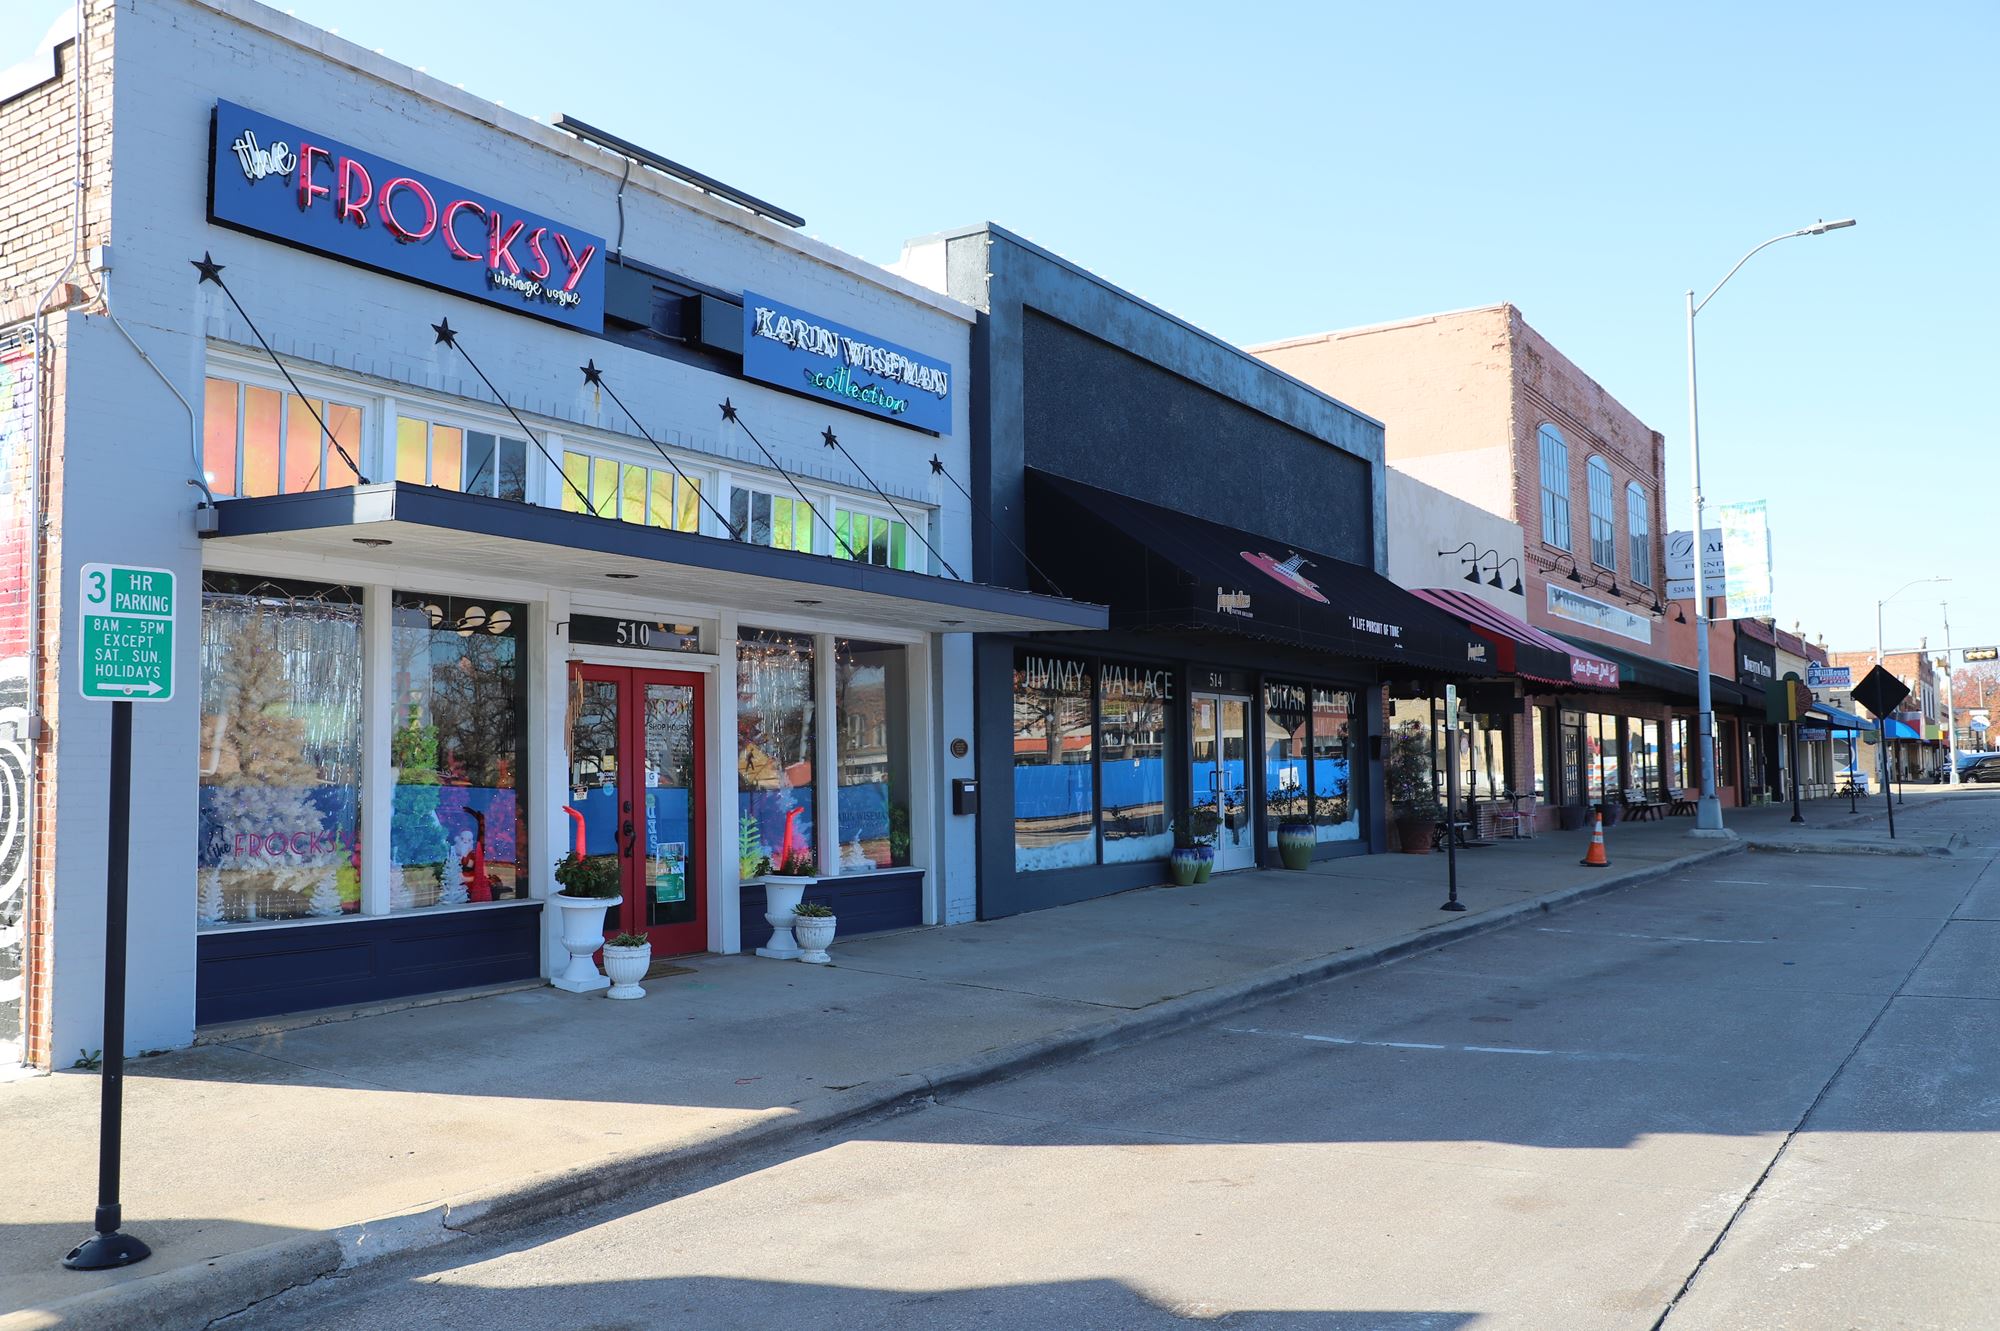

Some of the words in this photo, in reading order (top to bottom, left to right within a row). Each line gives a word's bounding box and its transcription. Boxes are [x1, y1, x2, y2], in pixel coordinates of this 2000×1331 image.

[232, 128, 297, 180] the
[299, 141, 596, 292] FROCKSY
[546, 286, 582, 307] vogue
[754, 306, 840, 359] KARIN
[840, 336, 949, 396] WISEMAN
[814, 366, 907, 413] collection
[87, 571, 107, 604] 3
[130, 574, 153, 592] HR
[115, 592, 169, 613] PARKING
[93, 618, 120, 632] 8AM
[140, 621, 165, 635] 5PM
[616, 621, 650, 646] 510
[103, 633, 154, 649] EXCEPT
[94, 648, 124, 662] SAT.
[132, 649, 162, 664] SUN.
[95, 663, 161, 679] HOLIDAYS
[1021, 656, 1085, 692] JIMMY
[1100, 664, 1173, 700] WALLACE
[1209, 672, 1222, 688] 514
[234, 831, 361, 858] FROCKSY
